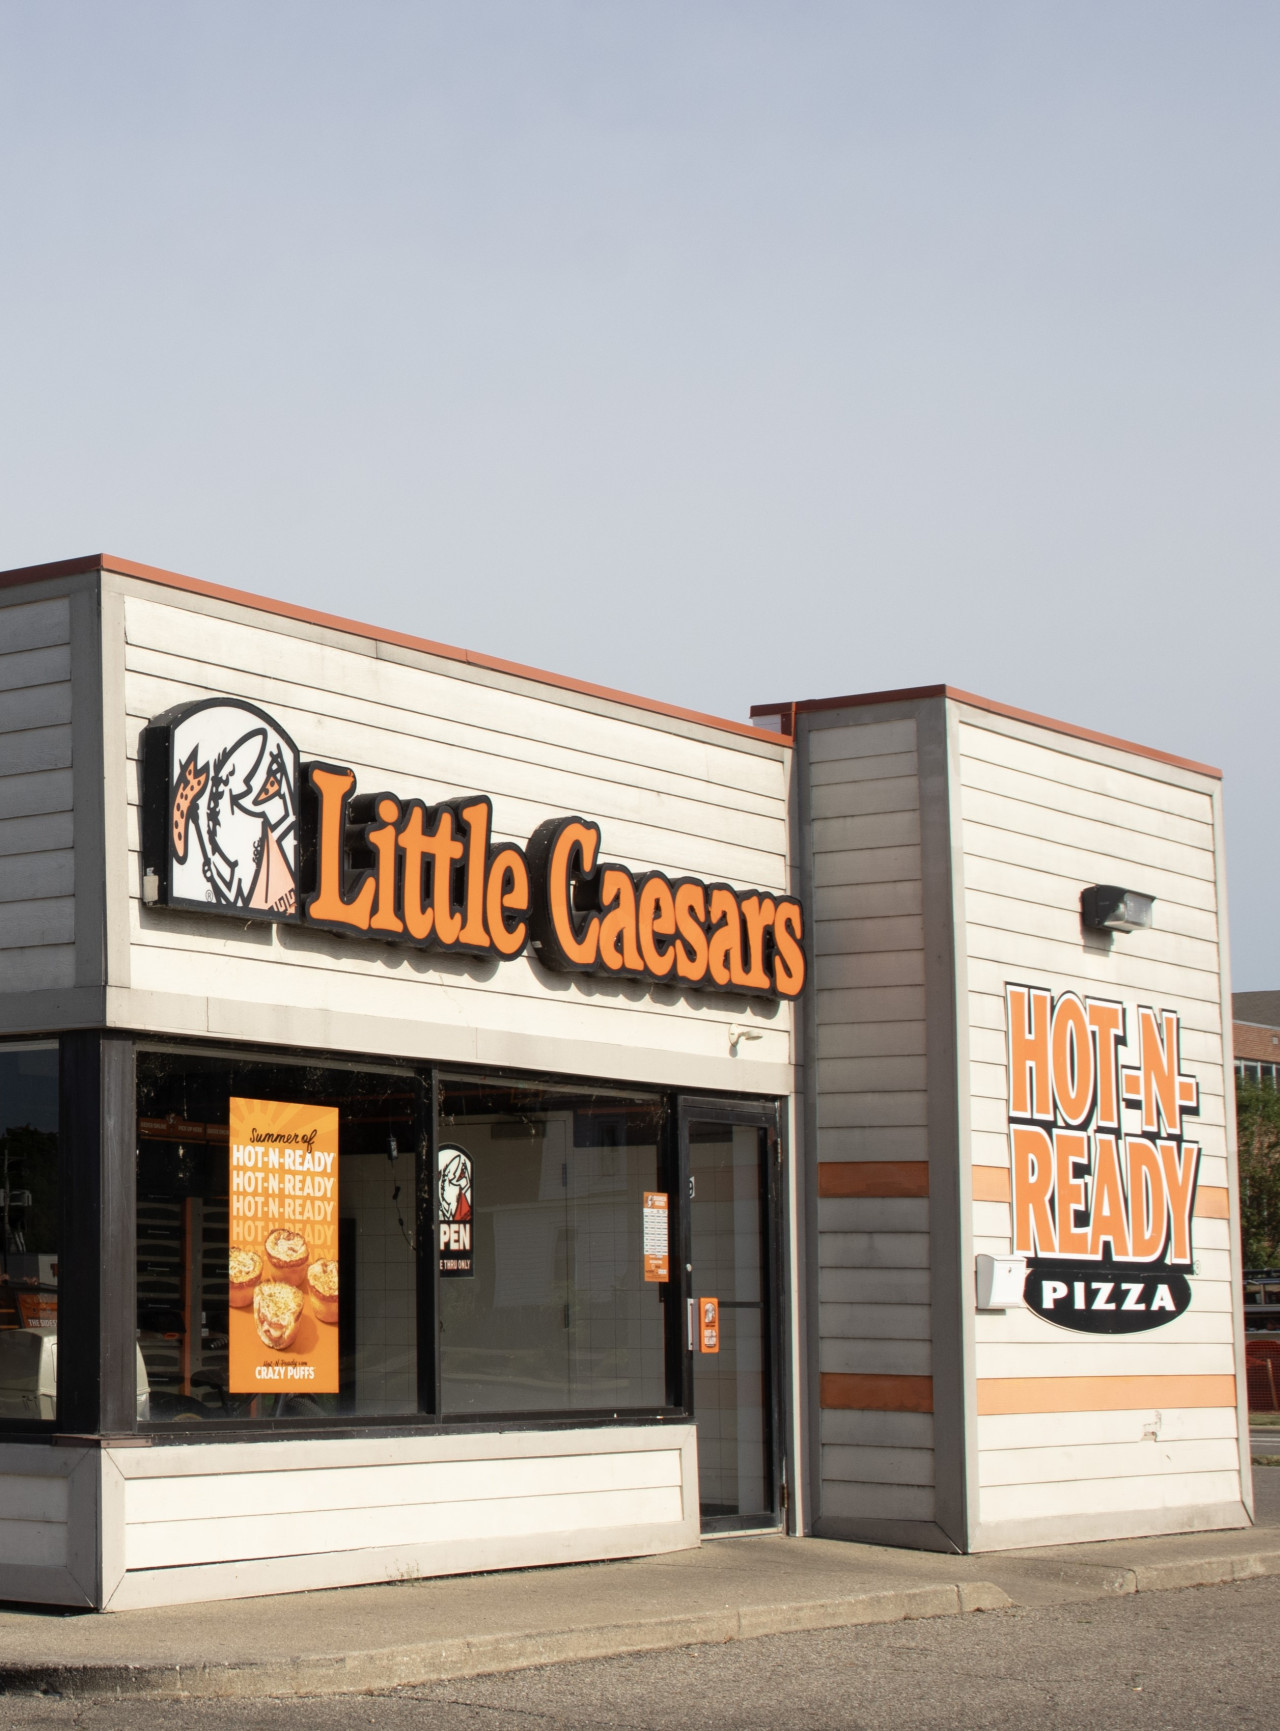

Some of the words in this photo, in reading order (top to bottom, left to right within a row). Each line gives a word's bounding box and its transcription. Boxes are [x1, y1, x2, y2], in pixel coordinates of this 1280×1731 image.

[310, 768, 527, 954] Little
[551, 821, 806, 997] Caesars
[1005, 984, 1197, 1134] HOT-N-
[250, 1128, 300, 1143] Summer
[301, 1129, 317, 1153] of
[232, 1144, 335, 1173] HOT-N-READY
[232, 1170, 335, 1198] HOT-N-READY
[1009, 1122, 1200, 1265] READY
[232, 1195, 334, 1221] HOT-N-READY
[232, 1219, 334, 1245] HOT-EADY
[439, 1223, 471, 1250] PEN
[444, 1259, 458, 1270] THRU
[458, 1259, 471, 1270] ONLY
[1041, 1280, 1177, 1312] PIZZA
[255, 1366, 285, 1379] CRAZY
[287, 1366, 315, 1379] PUFFS
